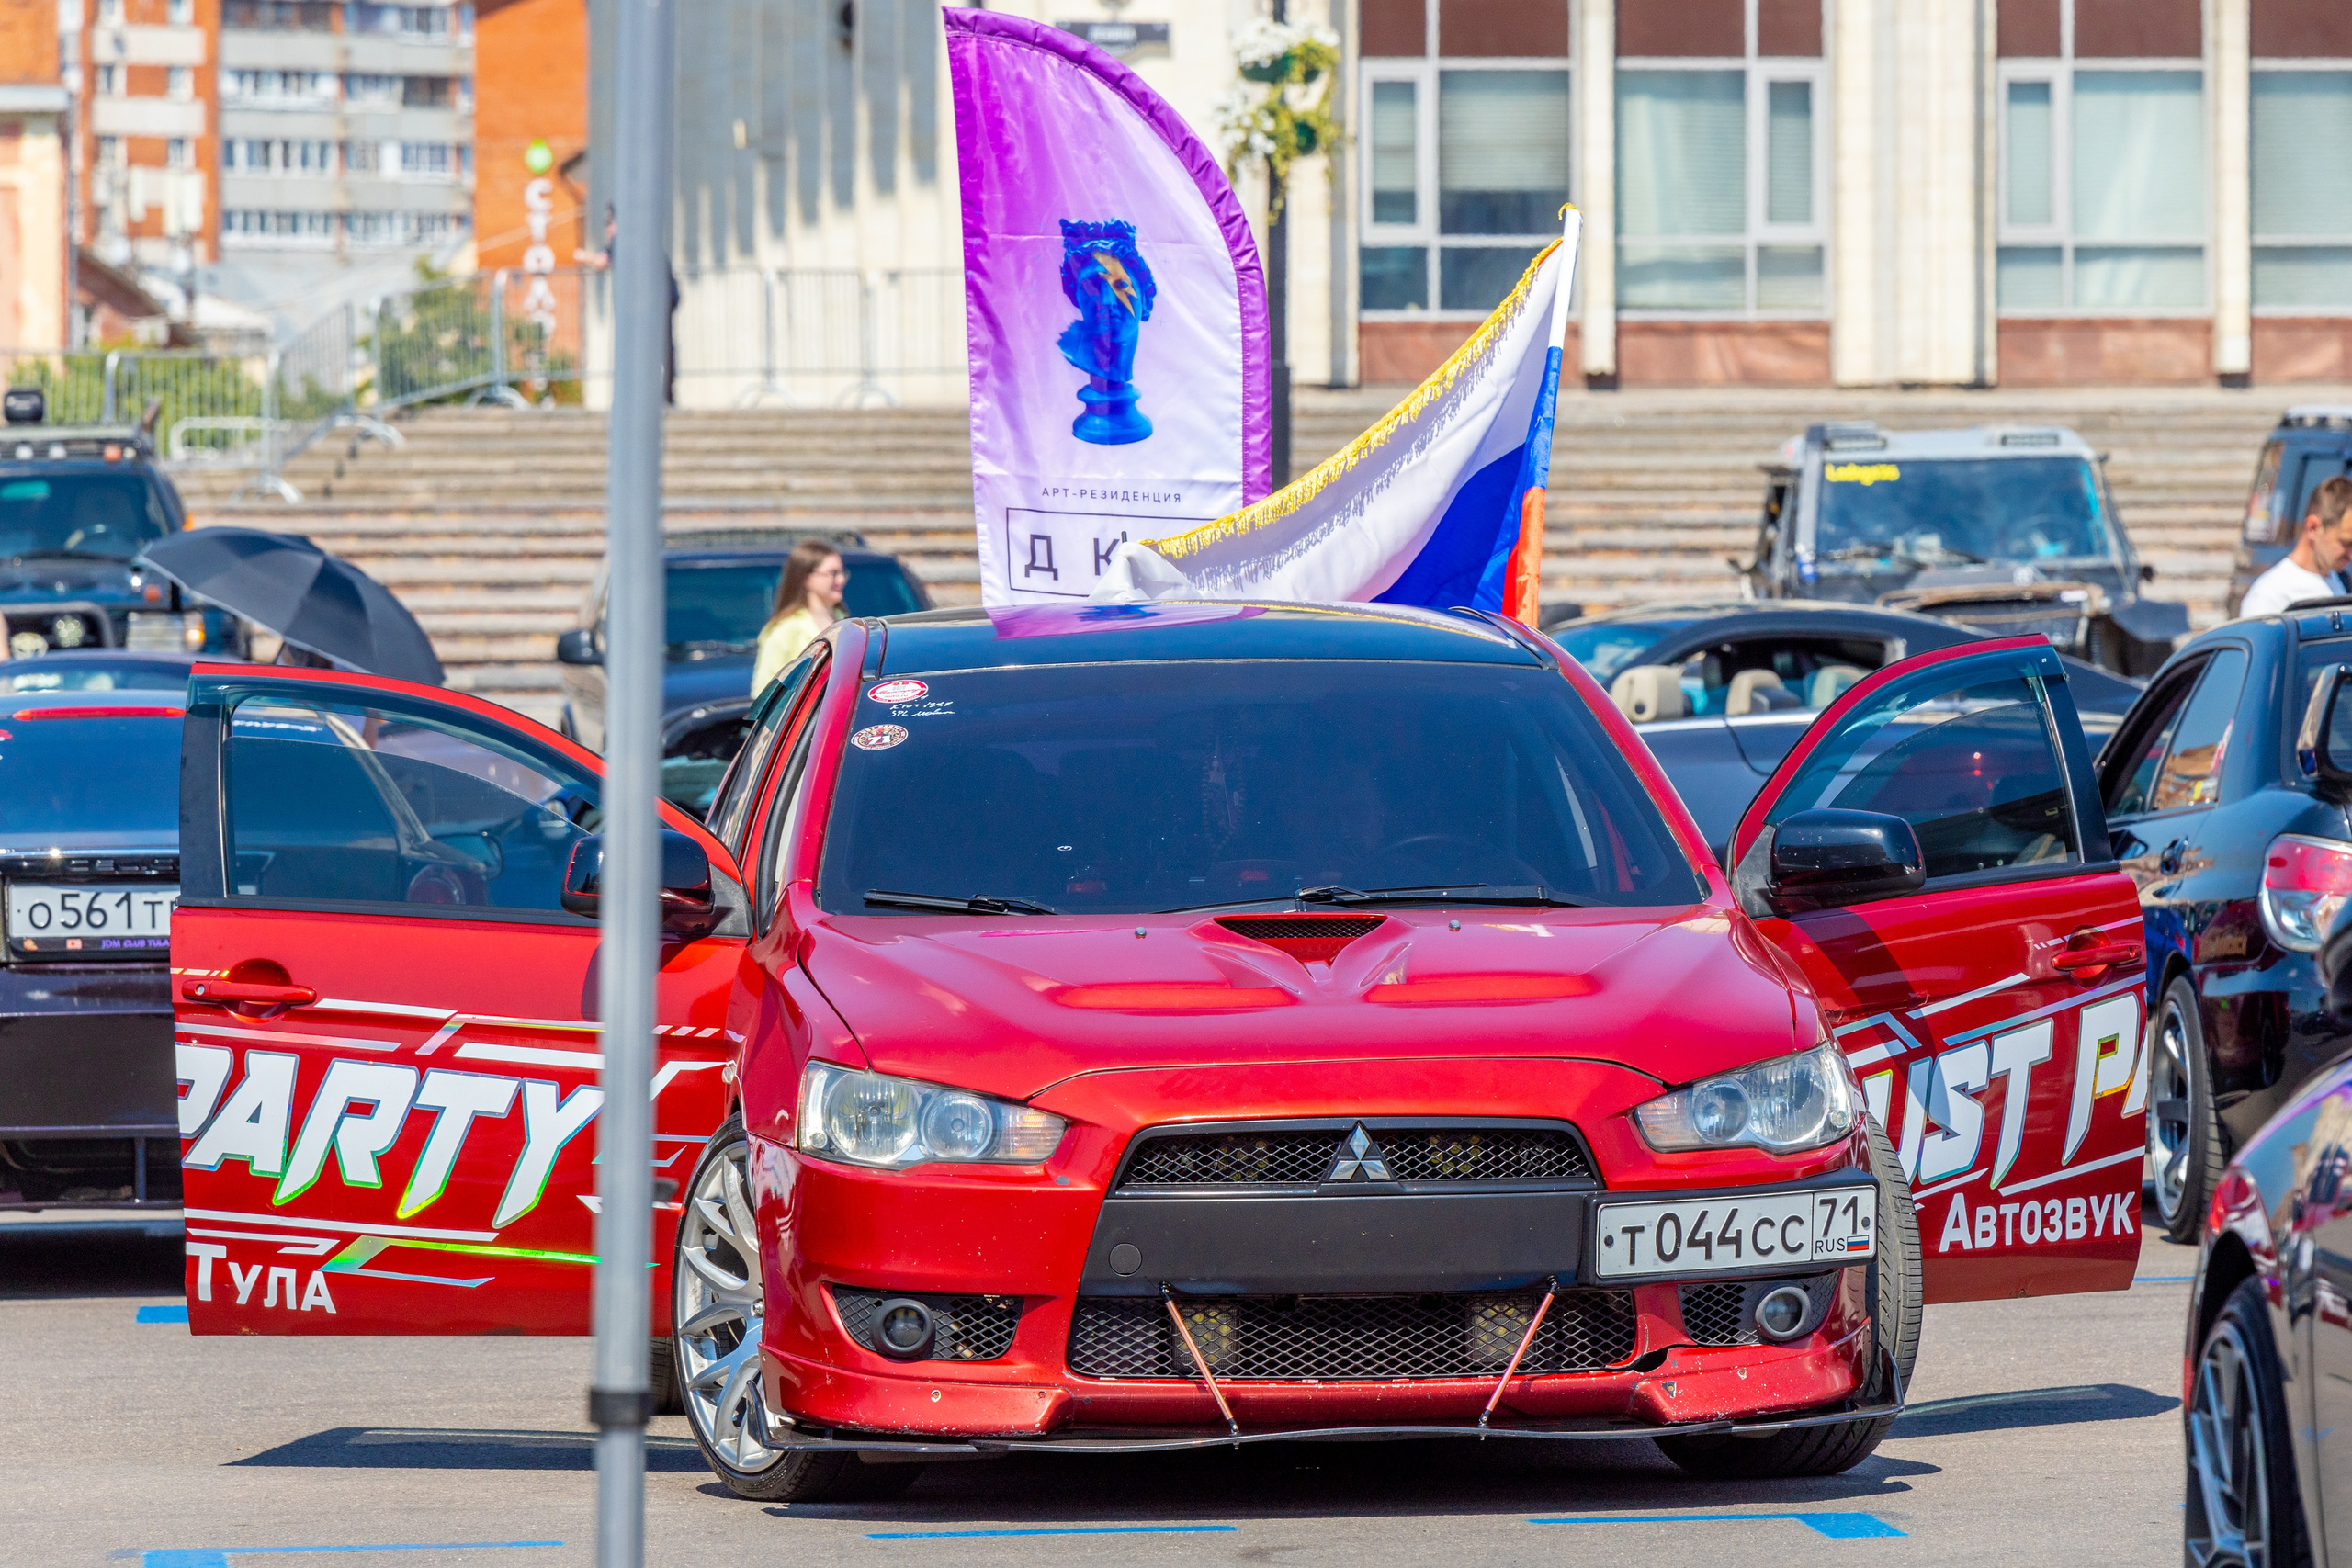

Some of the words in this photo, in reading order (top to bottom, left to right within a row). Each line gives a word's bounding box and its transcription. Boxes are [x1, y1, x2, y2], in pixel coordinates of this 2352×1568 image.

[1042, 487, 1182, 503] АРТ-РЕЗИДЕНЦИЯ
[1024, 534, 1121, 581] ДК
[101, 939, 121, 950] JDM
[123, 939, 146, 948] CLUB
[148, 938, 171, 948] TULA
[1862, 1018, 2054, 1190] UST
[1817, 1195, 1860, 1238] 71
[1814, 1237, 1846, 1255] RUS
